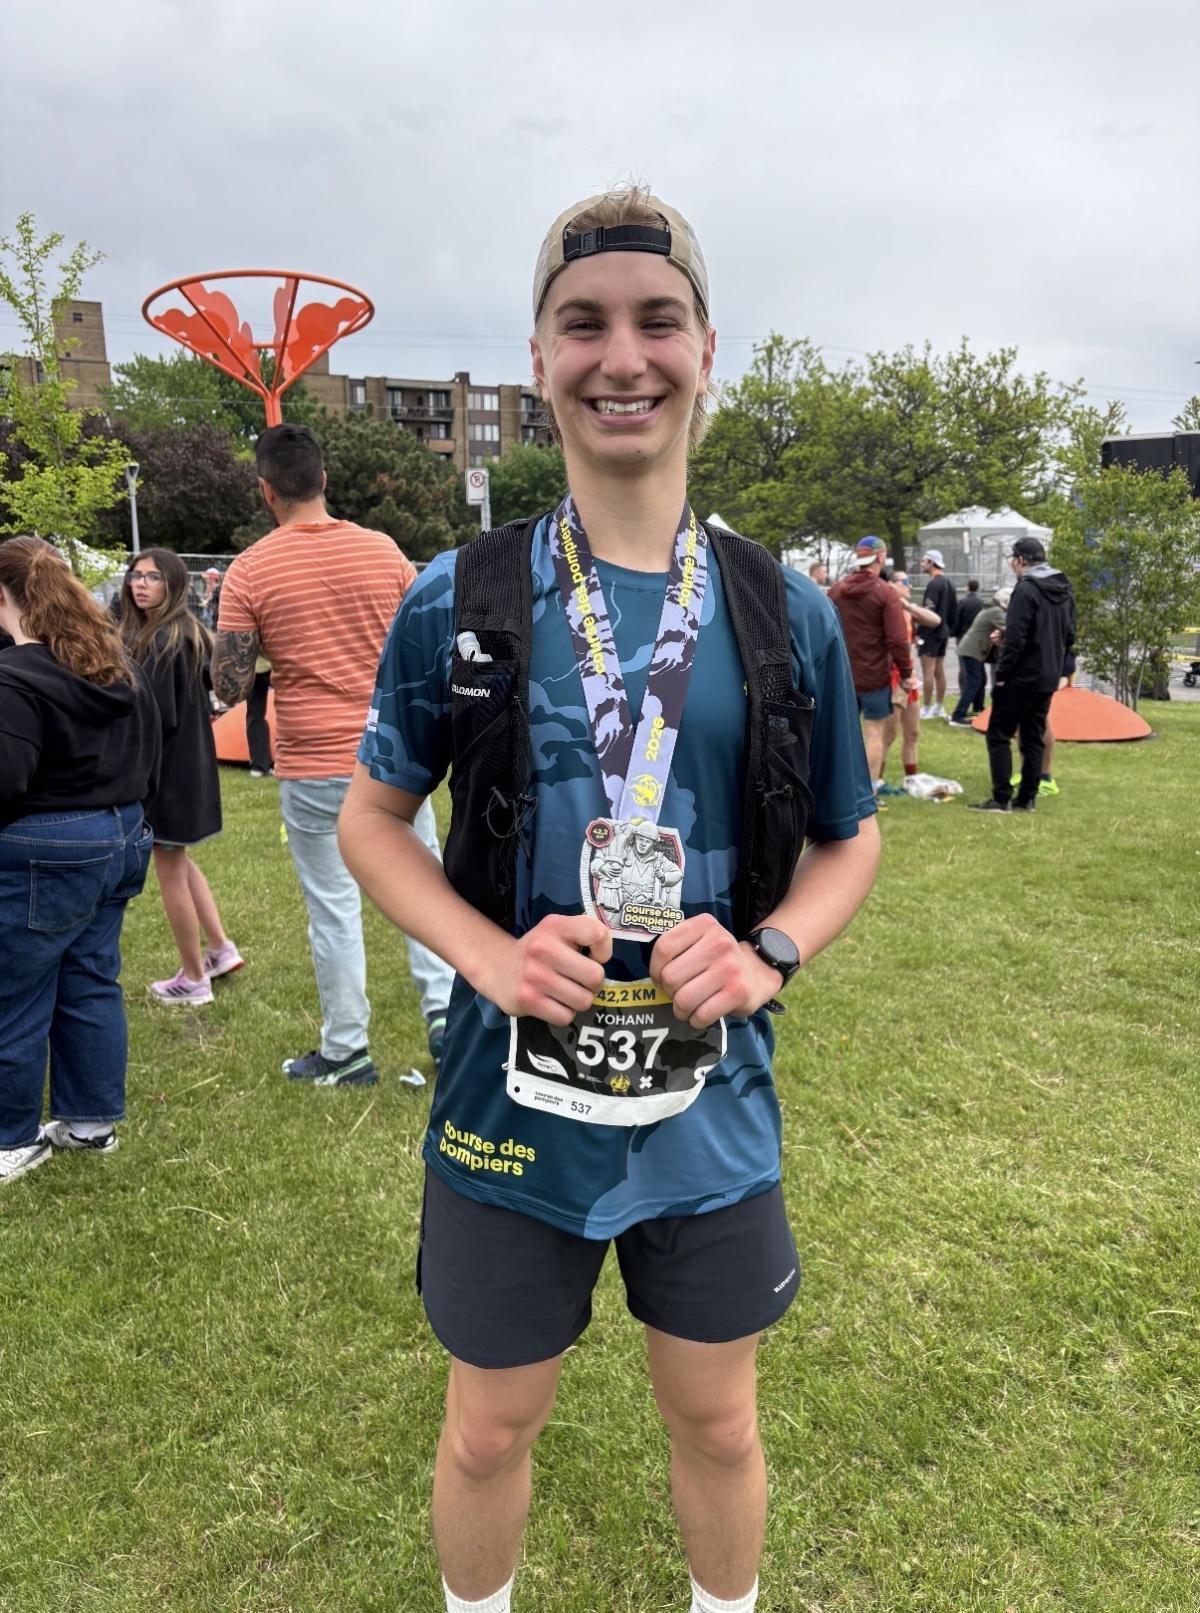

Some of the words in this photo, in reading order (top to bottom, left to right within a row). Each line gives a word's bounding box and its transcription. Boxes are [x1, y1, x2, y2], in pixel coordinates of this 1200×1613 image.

[559, 517, 586, 585] pompiers
[679, 557, 695, 608] course
[576, 585, 592, 615] des
[583, 616, 607, 675] course
[646, 716, 665, 762] 2026
[624, 913, 674, 928] pompiers
[625, 905, 661, 917] course
[662, 908, 682, 919] des
[596, 989, 629, 1003] 42,2
[632, 988, 656, 1001] KM
[595, 1013, 654, 1025] YOHANN
[576, 1025, 669, 1071] 537
[570, 1101, 592, 1115] 537
[500, 1138, 536, 1162] des
